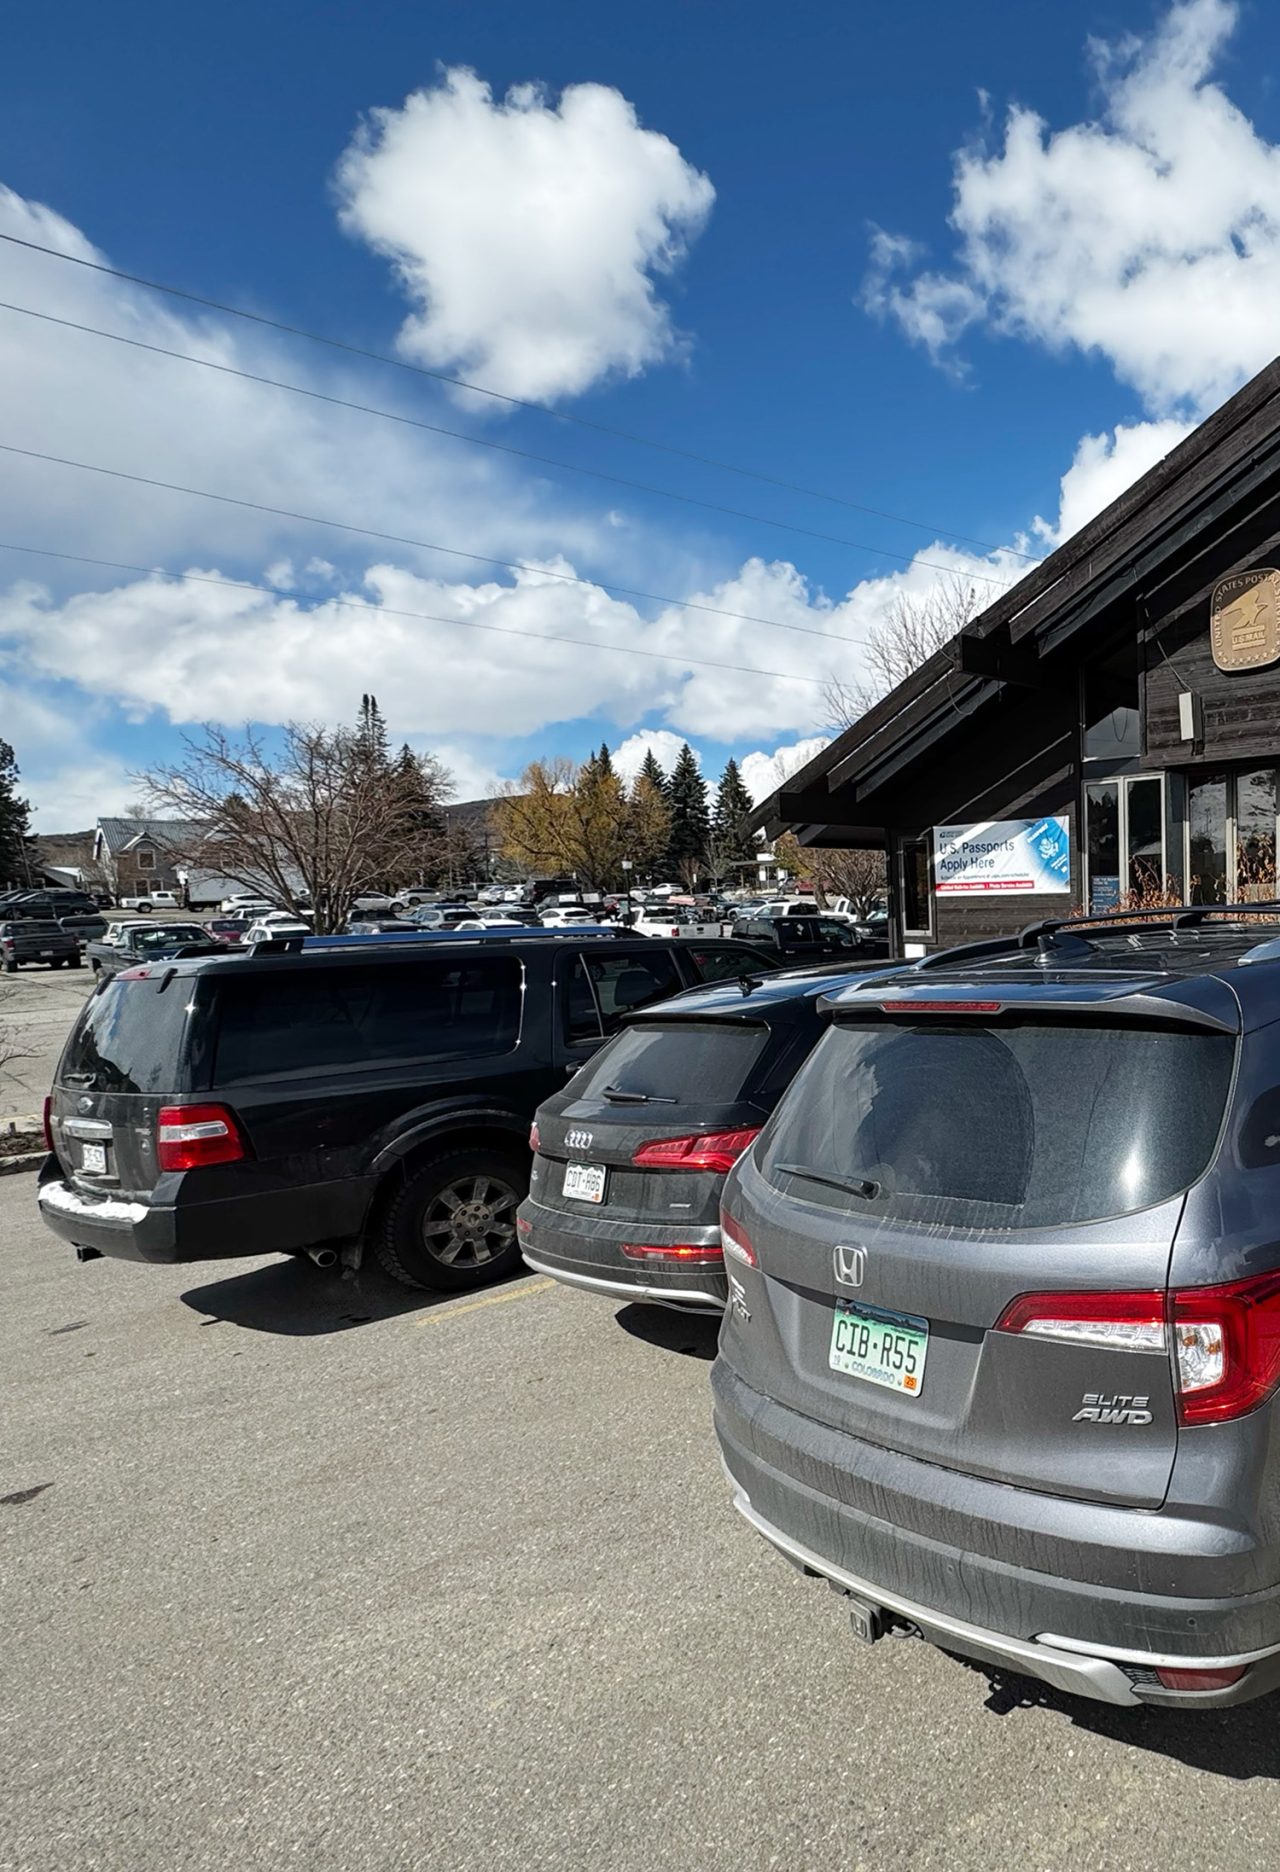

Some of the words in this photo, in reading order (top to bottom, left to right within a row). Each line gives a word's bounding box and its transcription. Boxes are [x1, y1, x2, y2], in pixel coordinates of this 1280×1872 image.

[1216, 579, 1243, 602] STATES
[1245, 573, 1280, 588] POSTAL
[939, 842, 959, 855] U.S.
[962, 839, 1015, 855] Passports
[940, 858, 968, 872] Apply
[970, 858, 995, 869] Here
[1081, 1393, 1150, 1407] ELITE
[1071, 1407, 1153, 1425] AWD
